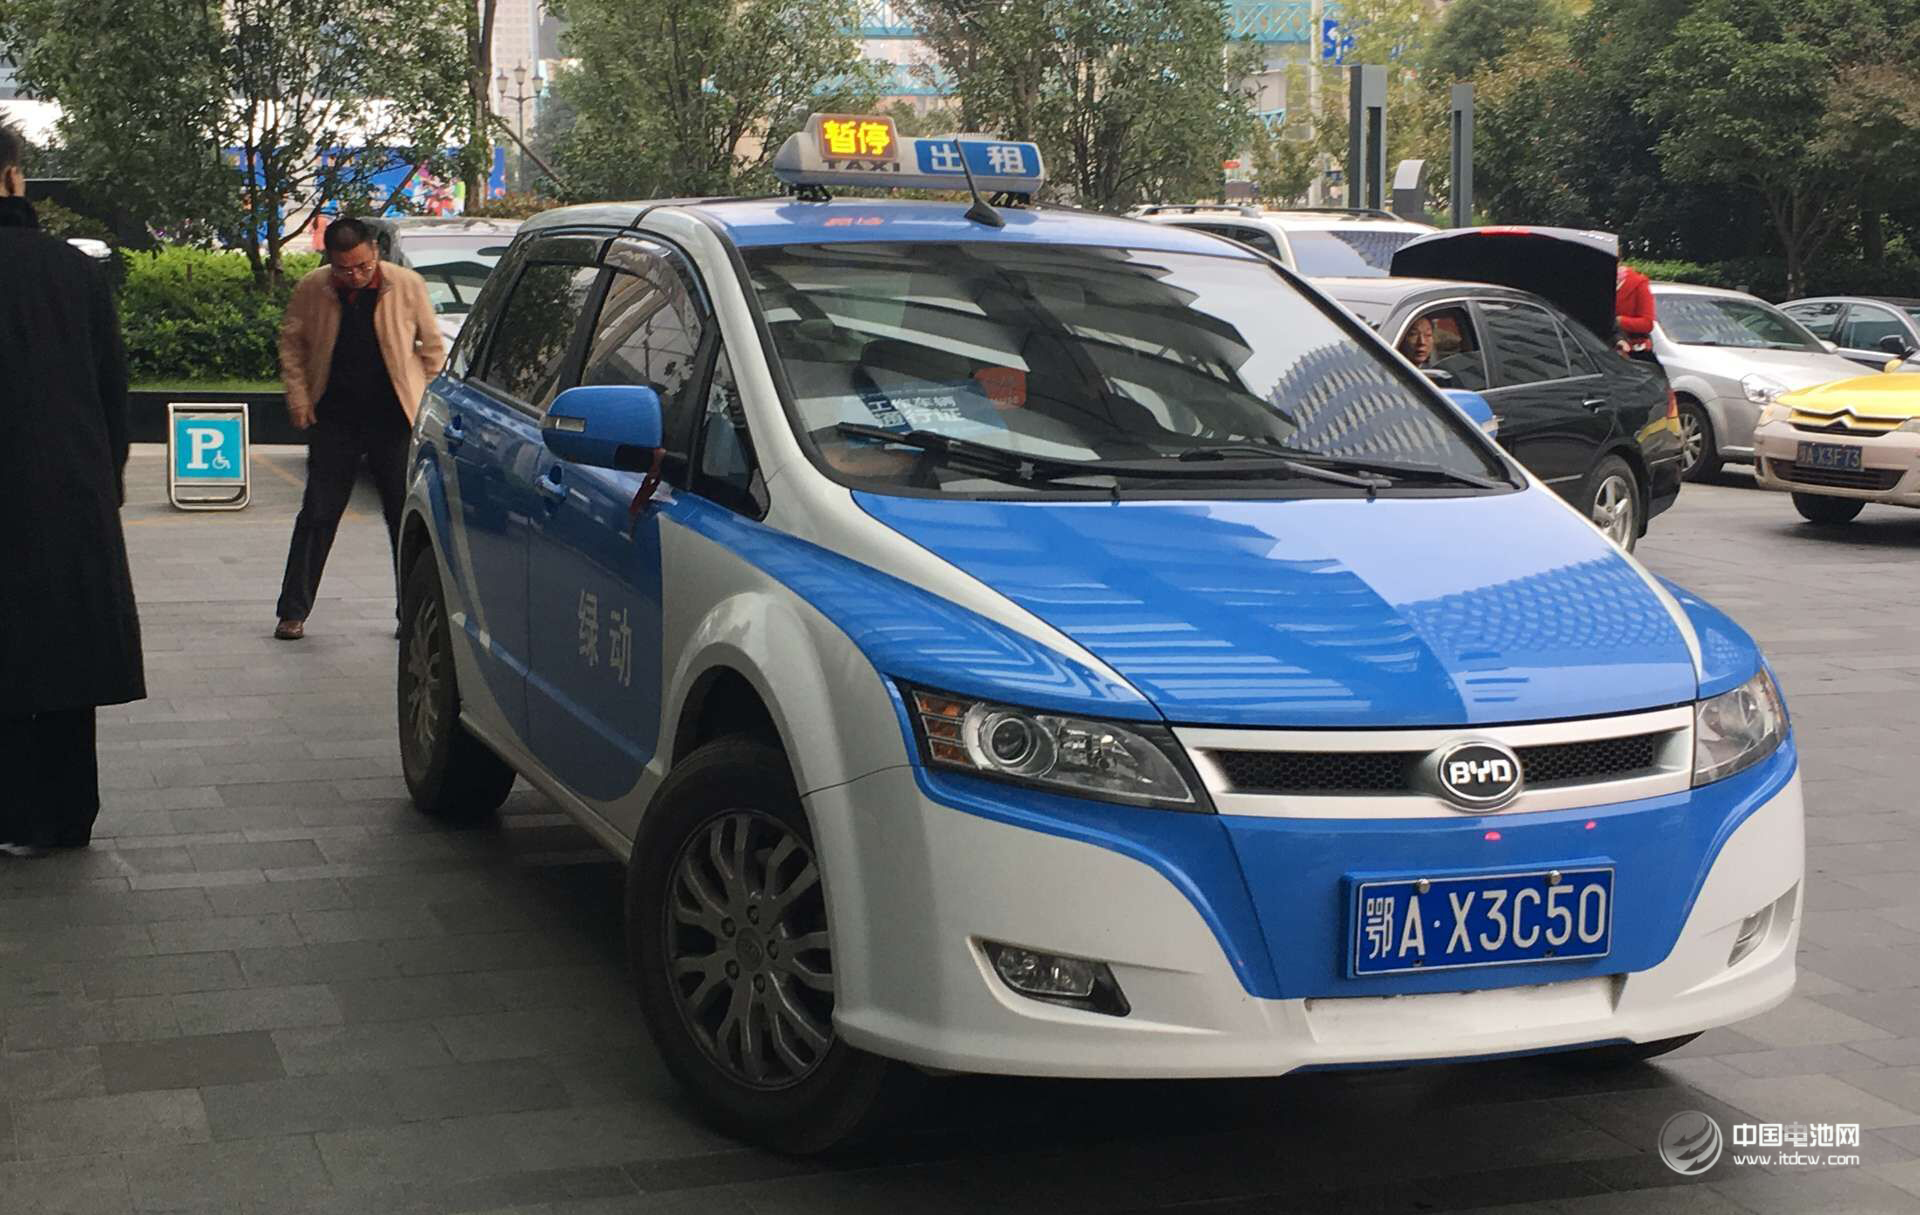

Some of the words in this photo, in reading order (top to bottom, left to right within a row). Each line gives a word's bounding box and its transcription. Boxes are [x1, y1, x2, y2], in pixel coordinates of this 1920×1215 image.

[823, 120, 890, 156] 暂停
[822, 159, 901, 173] TAXI
[929, 142, 1027, 174] 出租
[185, 428, 225, 470] P
[577, 588, 632, 687] 绿动
[1448, 760, 1512, 785] BYD
[1365, 884, 1606, 959] 鄂A·X3C50
